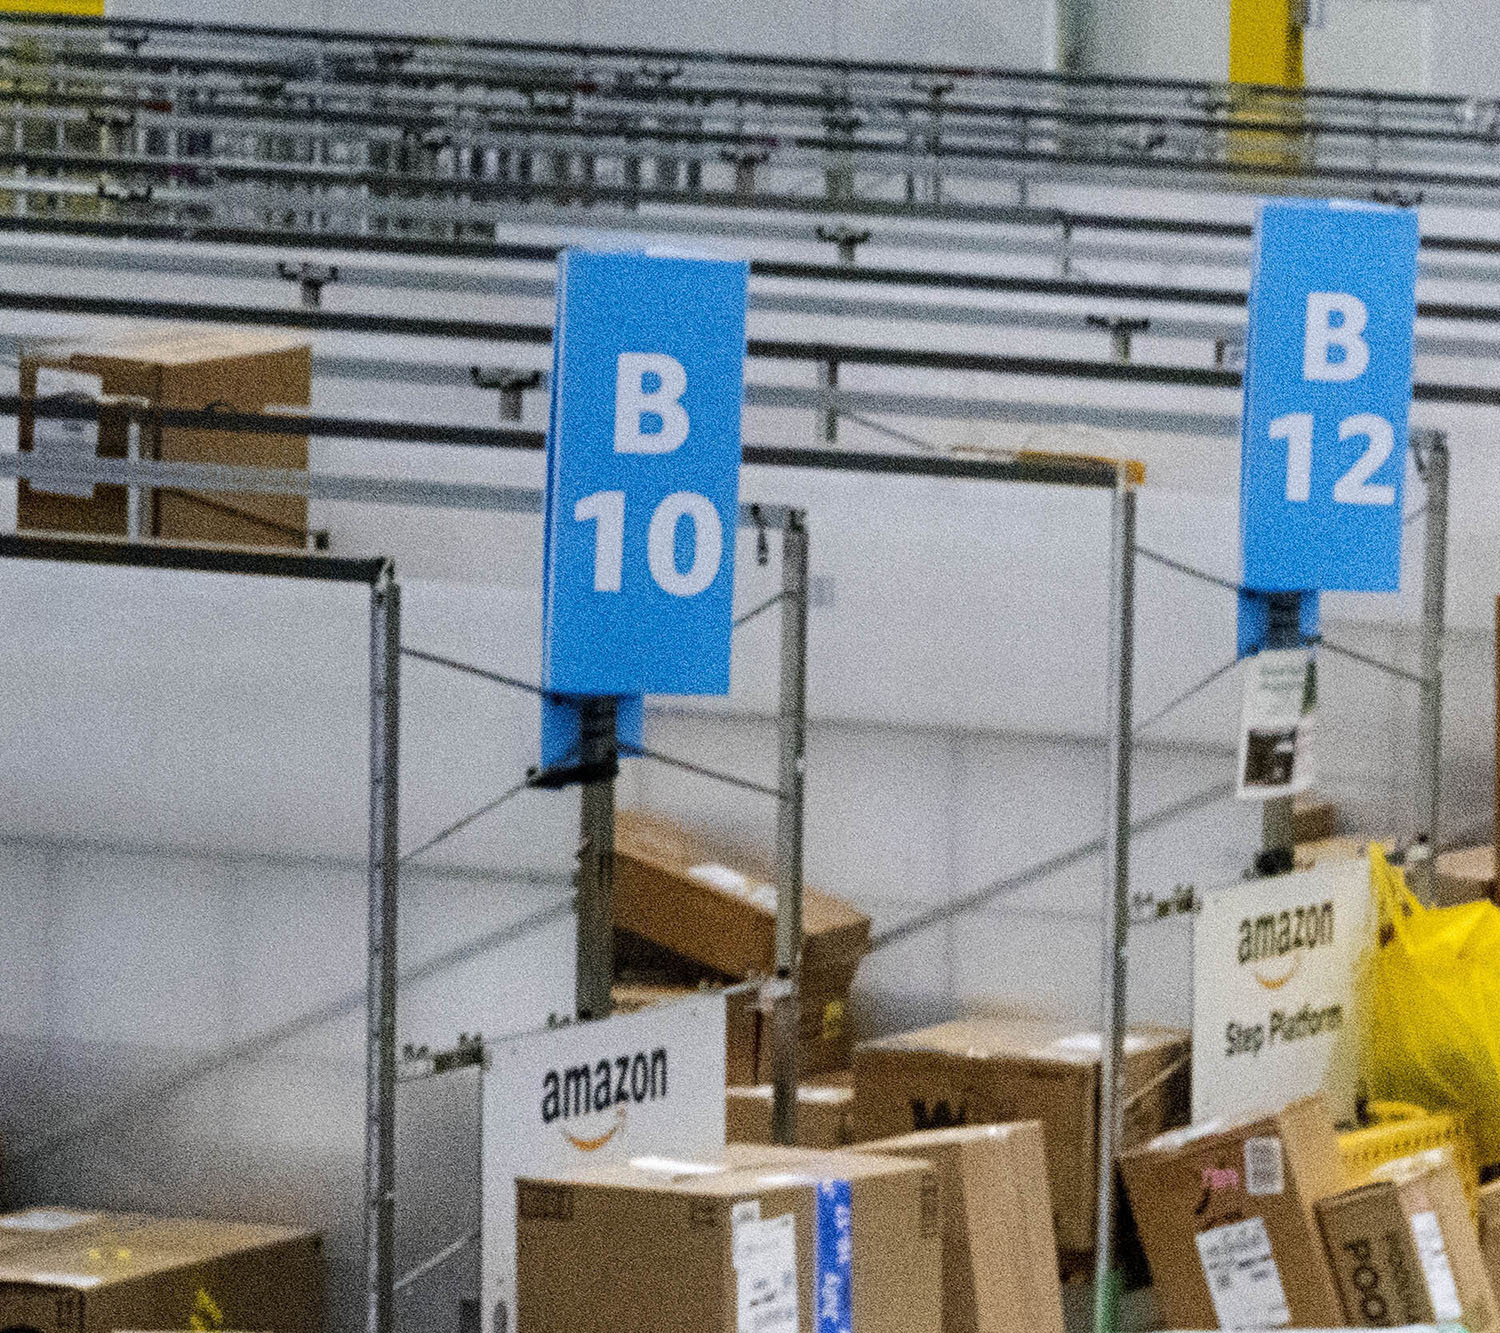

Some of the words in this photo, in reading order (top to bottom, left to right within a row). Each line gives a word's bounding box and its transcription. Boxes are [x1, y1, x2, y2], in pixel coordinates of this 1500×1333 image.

[1303, 291, 1369, 380] B
[613, 352, 689, 455] B
[1268, 413, 1395, 505] 12
[573, 491, 723, 596] 10
[1237, 901, 1334, 966] amazon
[1225, 1020, 1264, 1059] Step
[1268, 1003, 1342, 1045] Platform
[541, 1047, 668, 1125] amazon
